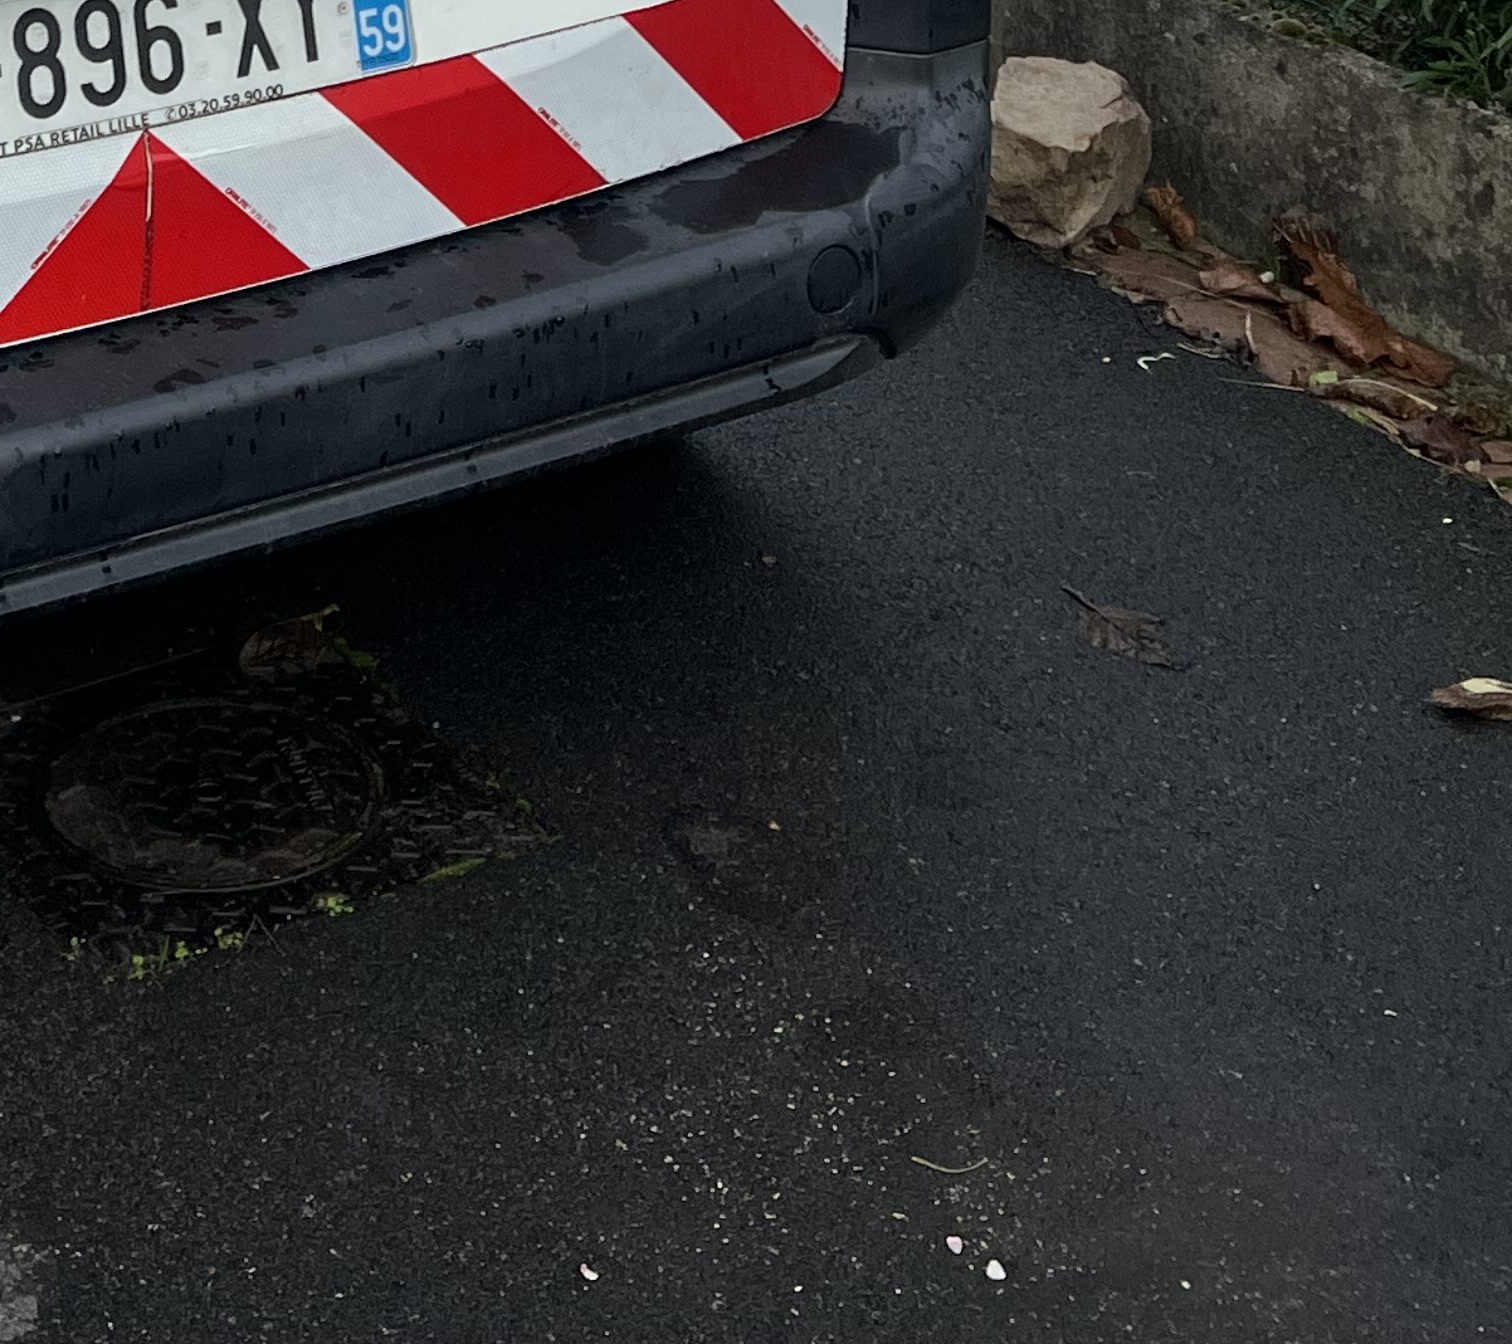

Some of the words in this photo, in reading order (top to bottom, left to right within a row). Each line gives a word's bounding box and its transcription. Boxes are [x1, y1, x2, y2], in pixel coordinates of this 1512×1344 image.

[359, 3, 406, 58] 59
[14, 135, 46, 154] PSA
[49, 123, 105, 148] RETAIL
[109, 112, 150, 135] LILLE
